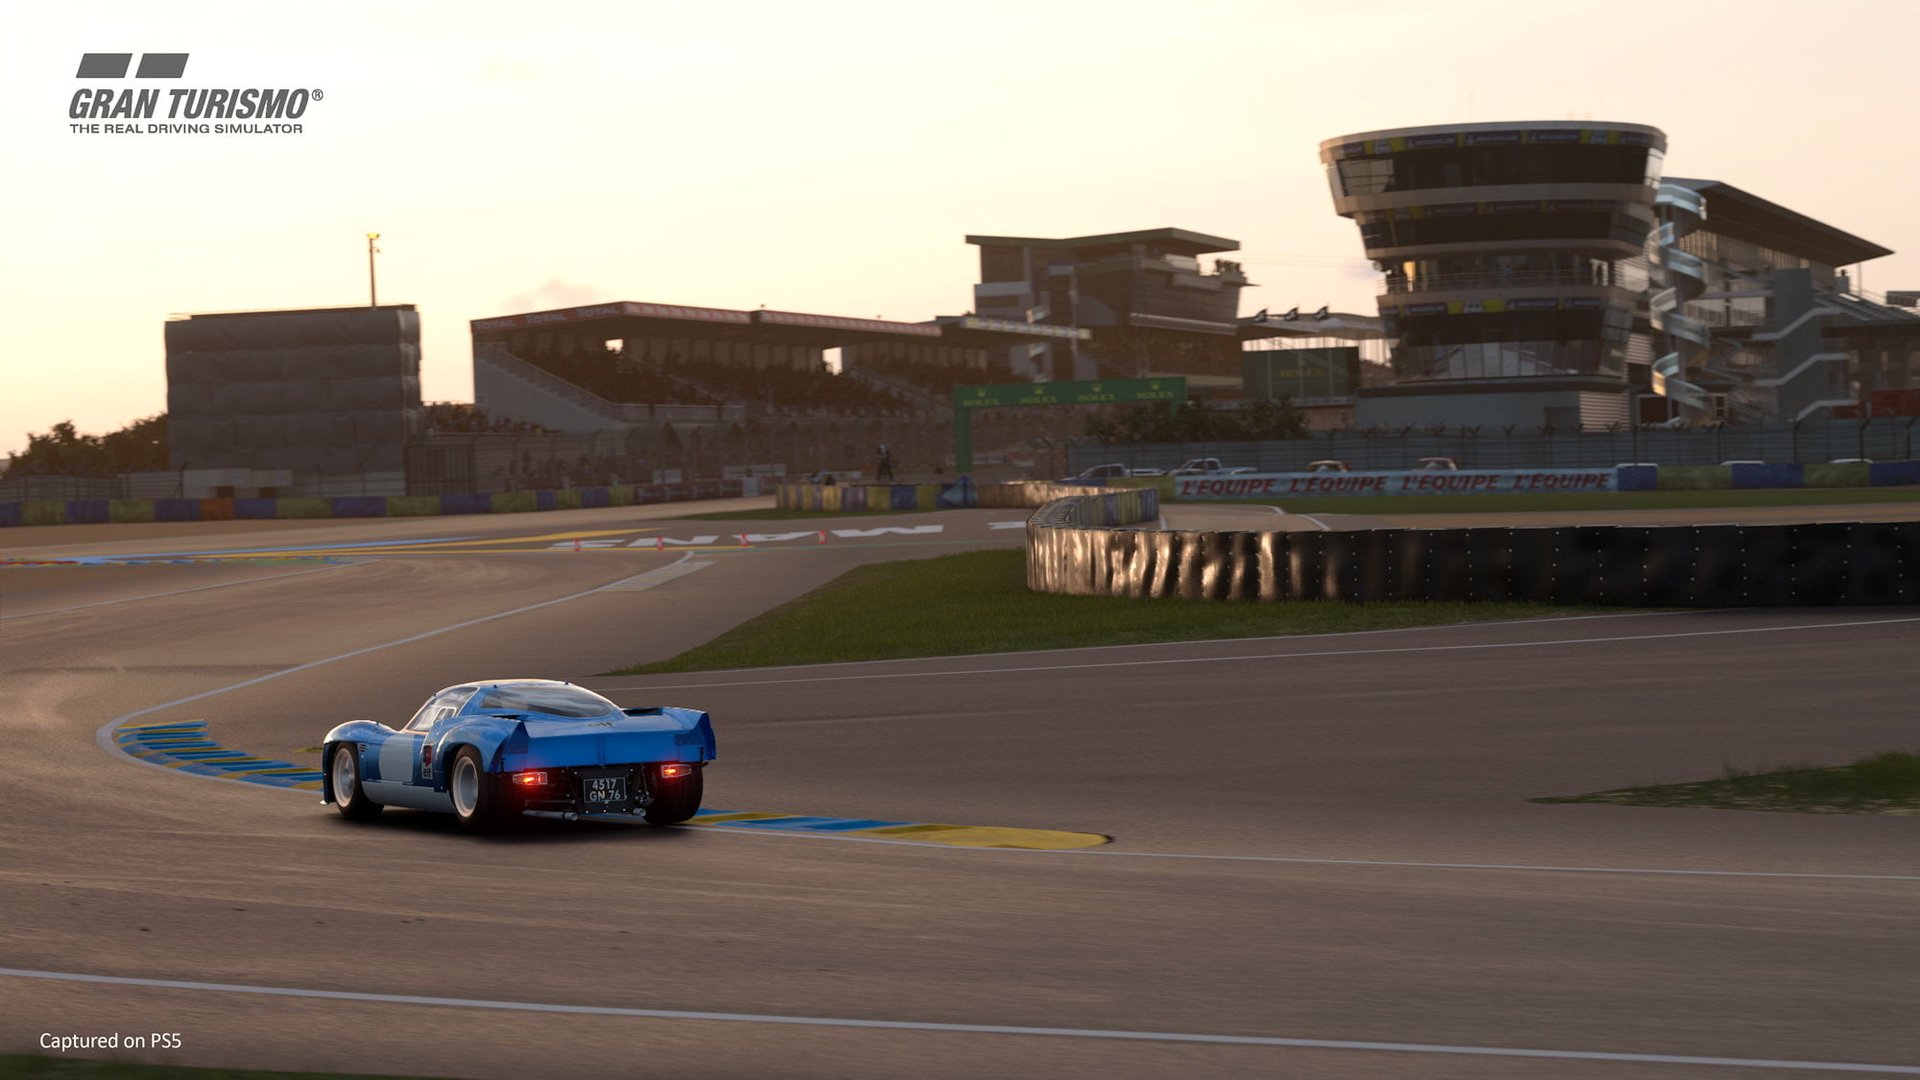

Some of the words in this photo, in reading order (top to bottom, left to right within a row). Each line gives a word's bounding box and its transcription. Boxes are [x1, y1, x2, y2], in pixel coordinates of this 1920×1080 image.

[575, 306, 619, 318] TOTAL
[525, 313, 568, 325] TOTAL
[475, 319, 516, 331] TOTAL
[1279, 368, 1326, 378] ROEX
[1020, 396, 1057, 404] ROLEX
[1078, 394, 1116, 402] ROLEX
[1136, 391, 1175, 399] ROLEX
[962, 399, 999, 407] ROLEX
[592, 779, 617, 790] 4517
[590, 790, 606, 801] GN
[608, 790, 621, 800] 76
